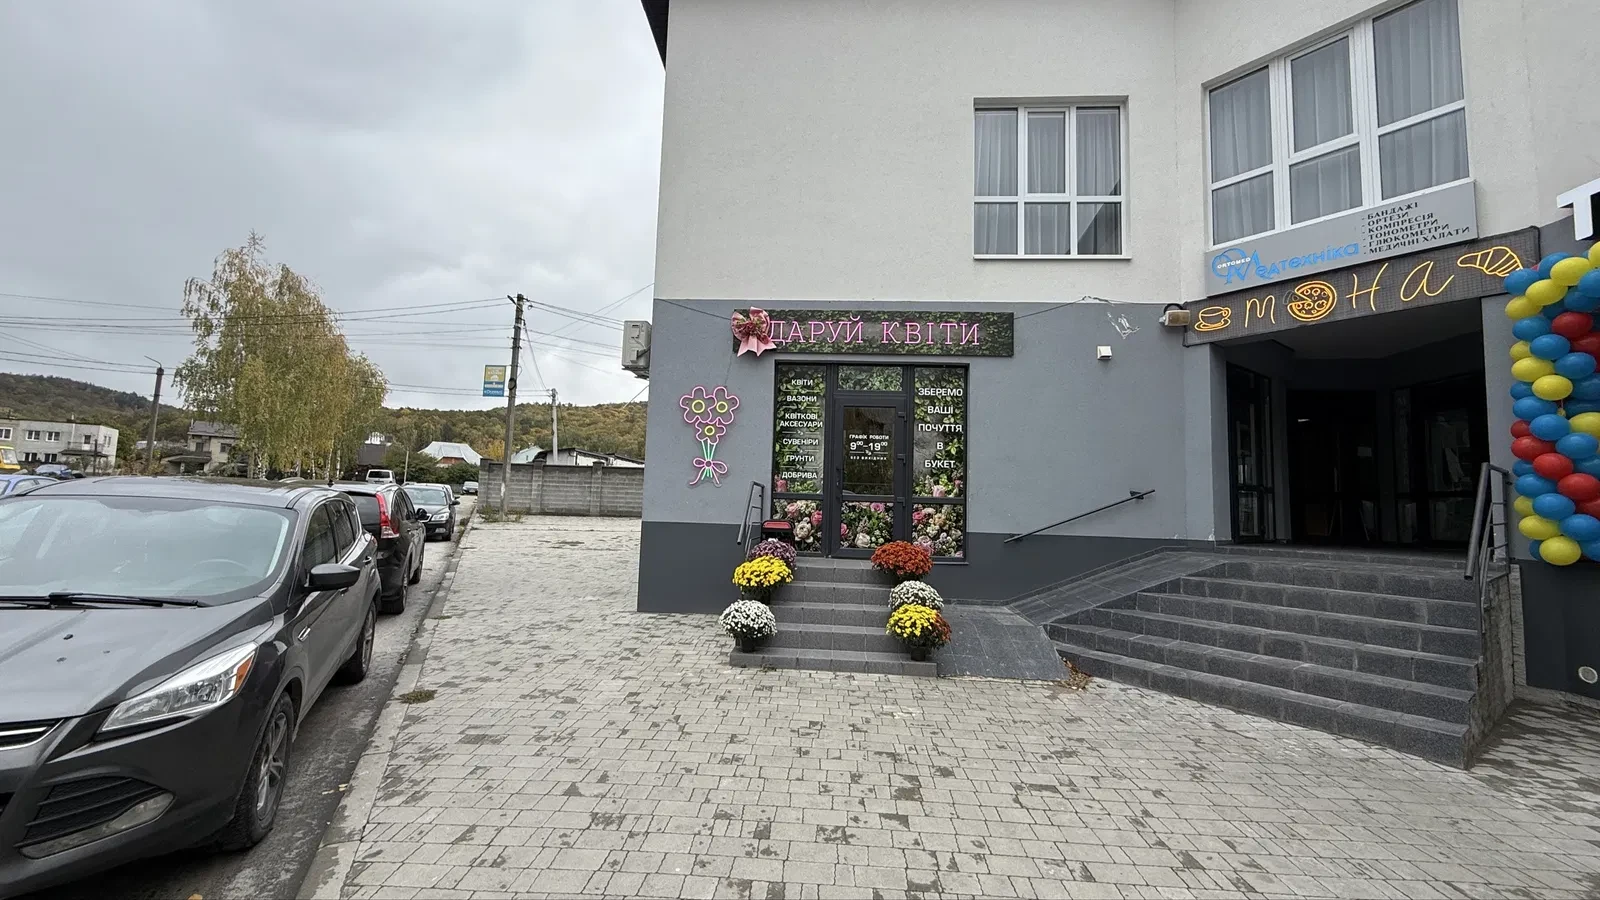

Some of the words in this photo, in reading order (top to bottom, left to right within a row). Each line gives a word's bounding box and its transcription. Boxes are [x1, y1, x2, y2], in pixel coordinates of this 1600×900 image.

[1367, 201, 1419, 220] БАНДАЖІ
[1367, 211, 1410, 227] ОРТЕЗИ
[1367, 212, 1435, 234] КОМПРЕСІЯ
[1368, 218, 1440, 241] ТОНОМЕТРИ
[1368, 223, 1450, 248] ГЛЮКОМЕТРИ
[1369, 236, 1420, 255] МЕДИЧНІ
[1422, 226, 1470, 243] ХАЛАТИ
[1216, 256, 1251, 269] ORTOMED
[768, 315, 864, 346] ДАРУЙ
[881, 321, 980, 346] КВІТИ
[918, 387, 963, 397] ЗБЕРЕМО
[927, 405, 954, 414] ВАШІ
[785, 412, 818, 420] КВІТКОВІ
[779, 420, 823, 428] АКСЕСУАРИ
[918, 423, 963, 433] ПОЧУТТЯ
[782, 438, 819, 446] СУВЕНІРИ
[936, 441, 944, 450] В
[924, 459, 956, 468] БУКЕТ
[782, 471, 818, 479] ДОБРИВА
